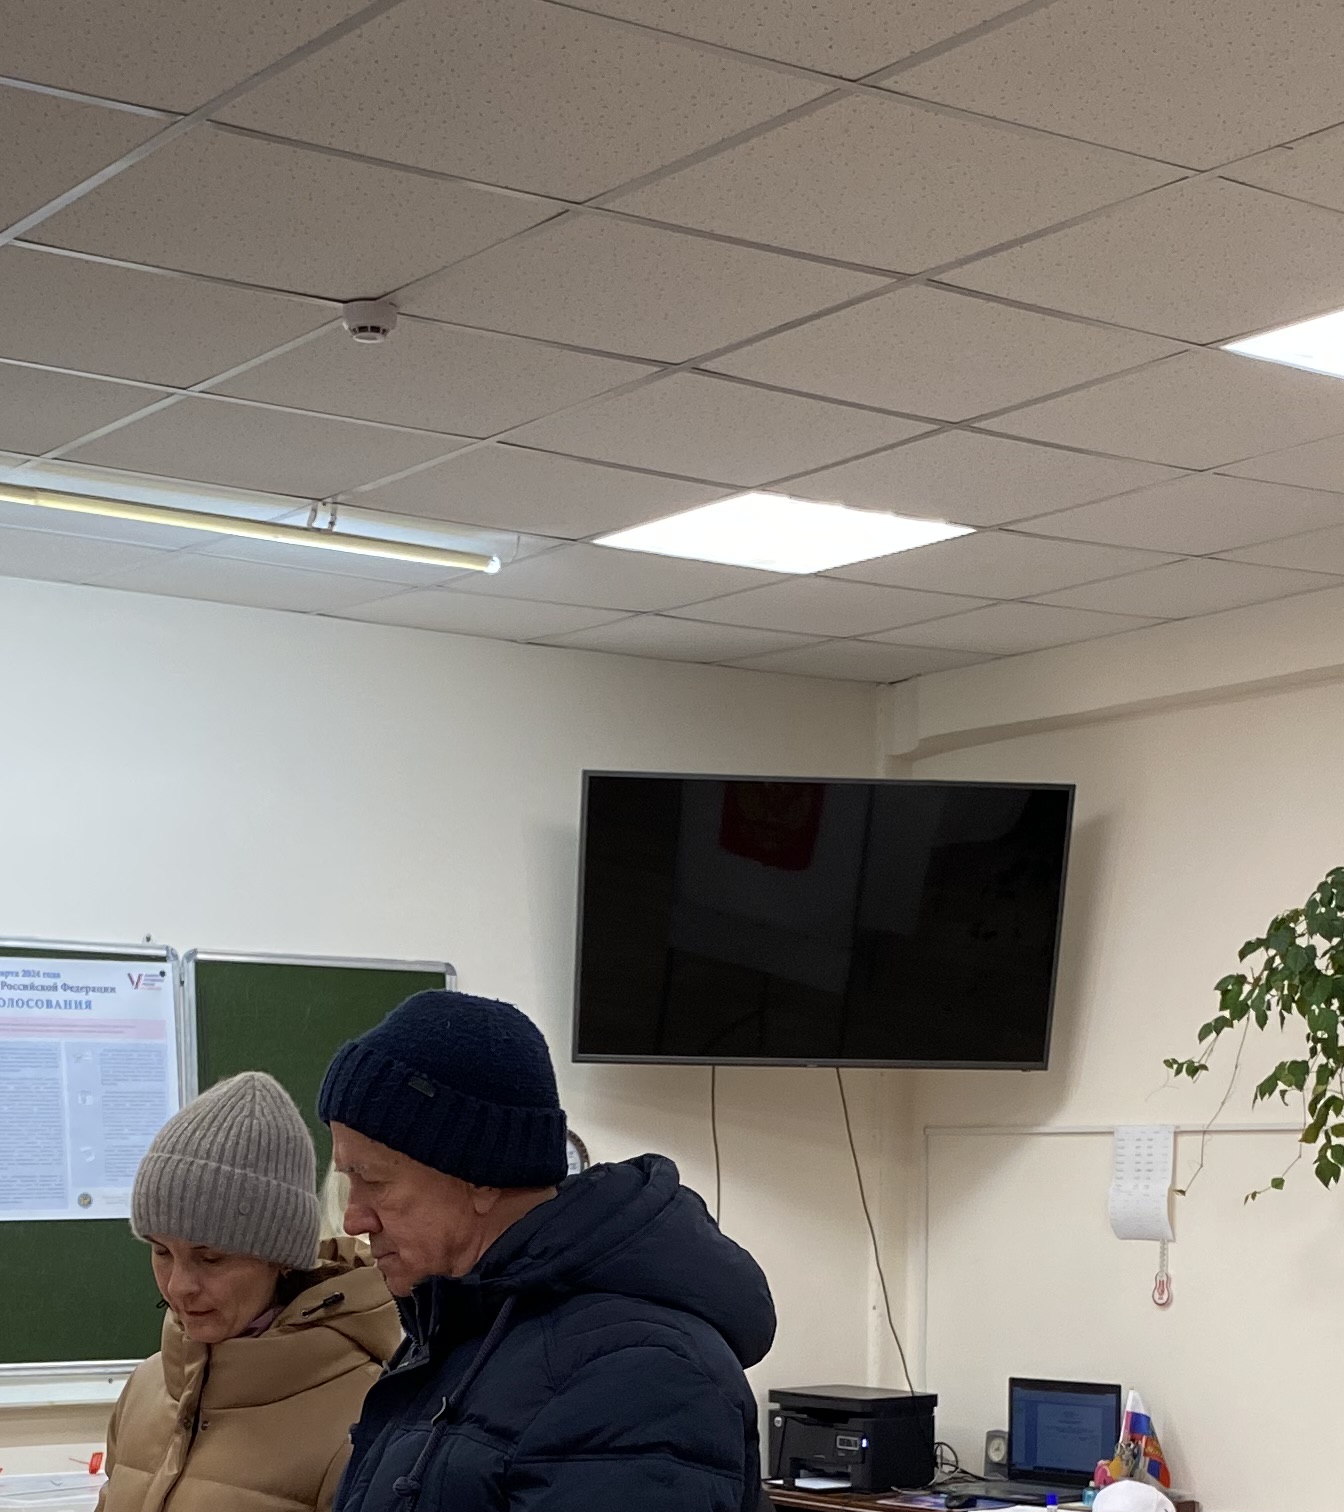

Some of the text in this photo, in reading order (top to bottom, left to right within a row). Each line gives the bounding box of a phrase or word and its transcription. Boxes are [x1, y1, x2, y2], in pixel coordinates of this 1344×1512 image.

[21, 969, 41, 978] 2024
[0, 980, 58, 993] Российской
[60, 982, 117, 995] Федерации
